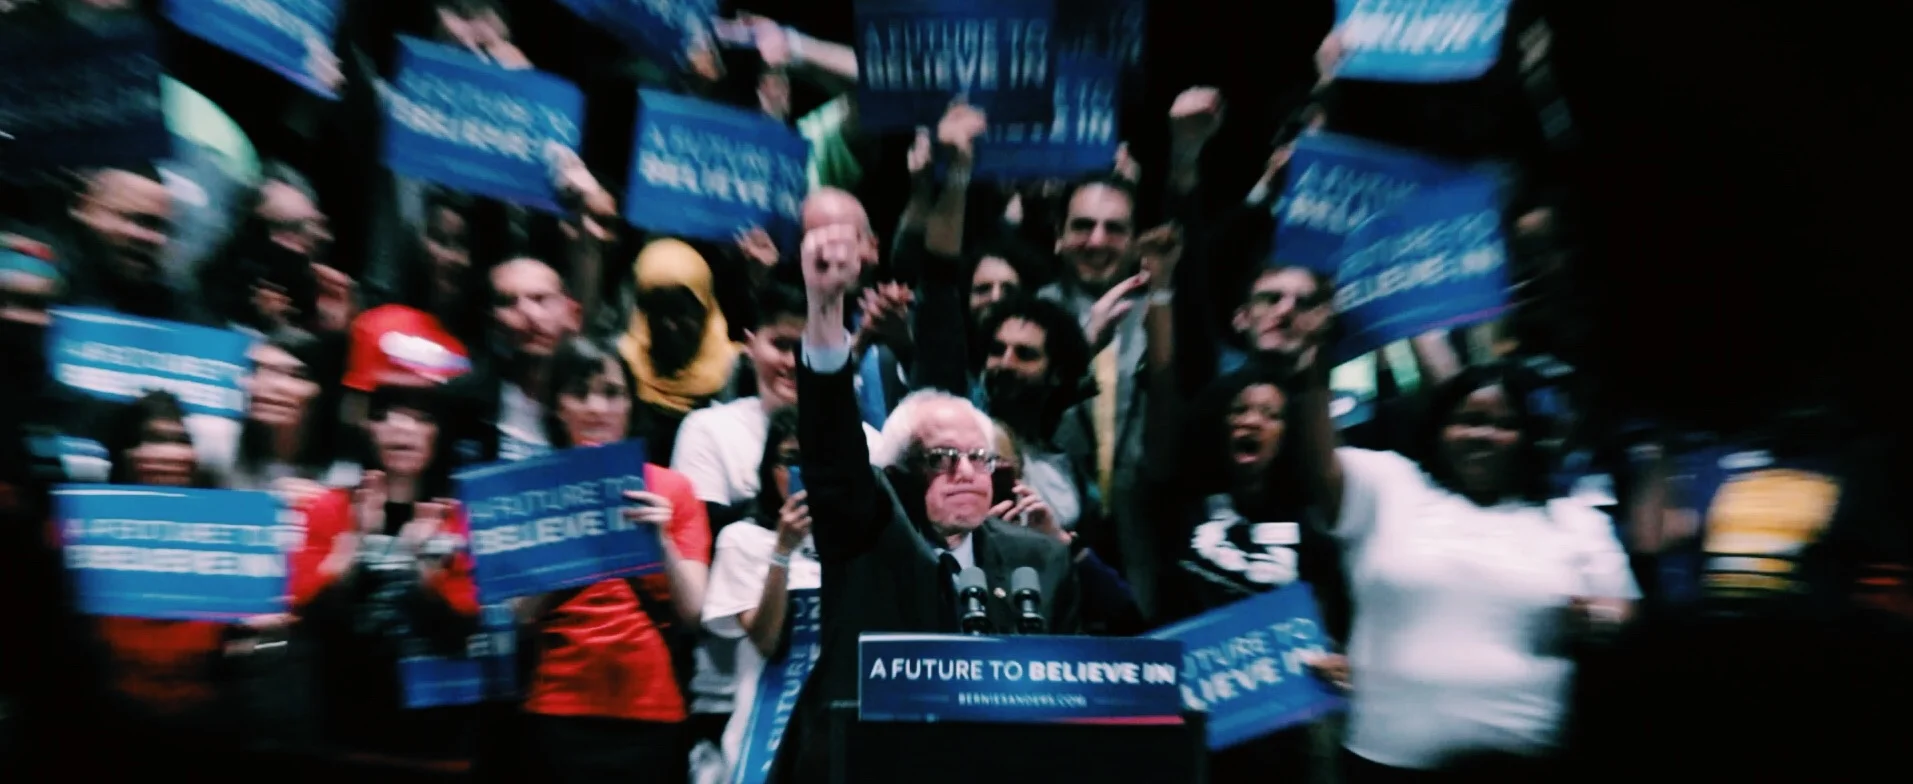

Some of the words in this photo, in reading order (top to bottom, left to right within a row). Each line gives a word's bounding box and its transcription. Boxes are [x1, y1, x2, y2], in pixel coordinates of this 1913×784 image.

[1006, 17, 1047, 52] TO
[866, 50, 998, 90] BELIEVE
[869, 658, 887, 680] A
[891, 657, 983, 681] FUTURE
[989, 660, 1023, 681] TO
[1028, 660, 1140, 684] BELIEVE
[1142, 662, 1177, 685] IN
[1179, 655, 1284, 713] LIEVE
